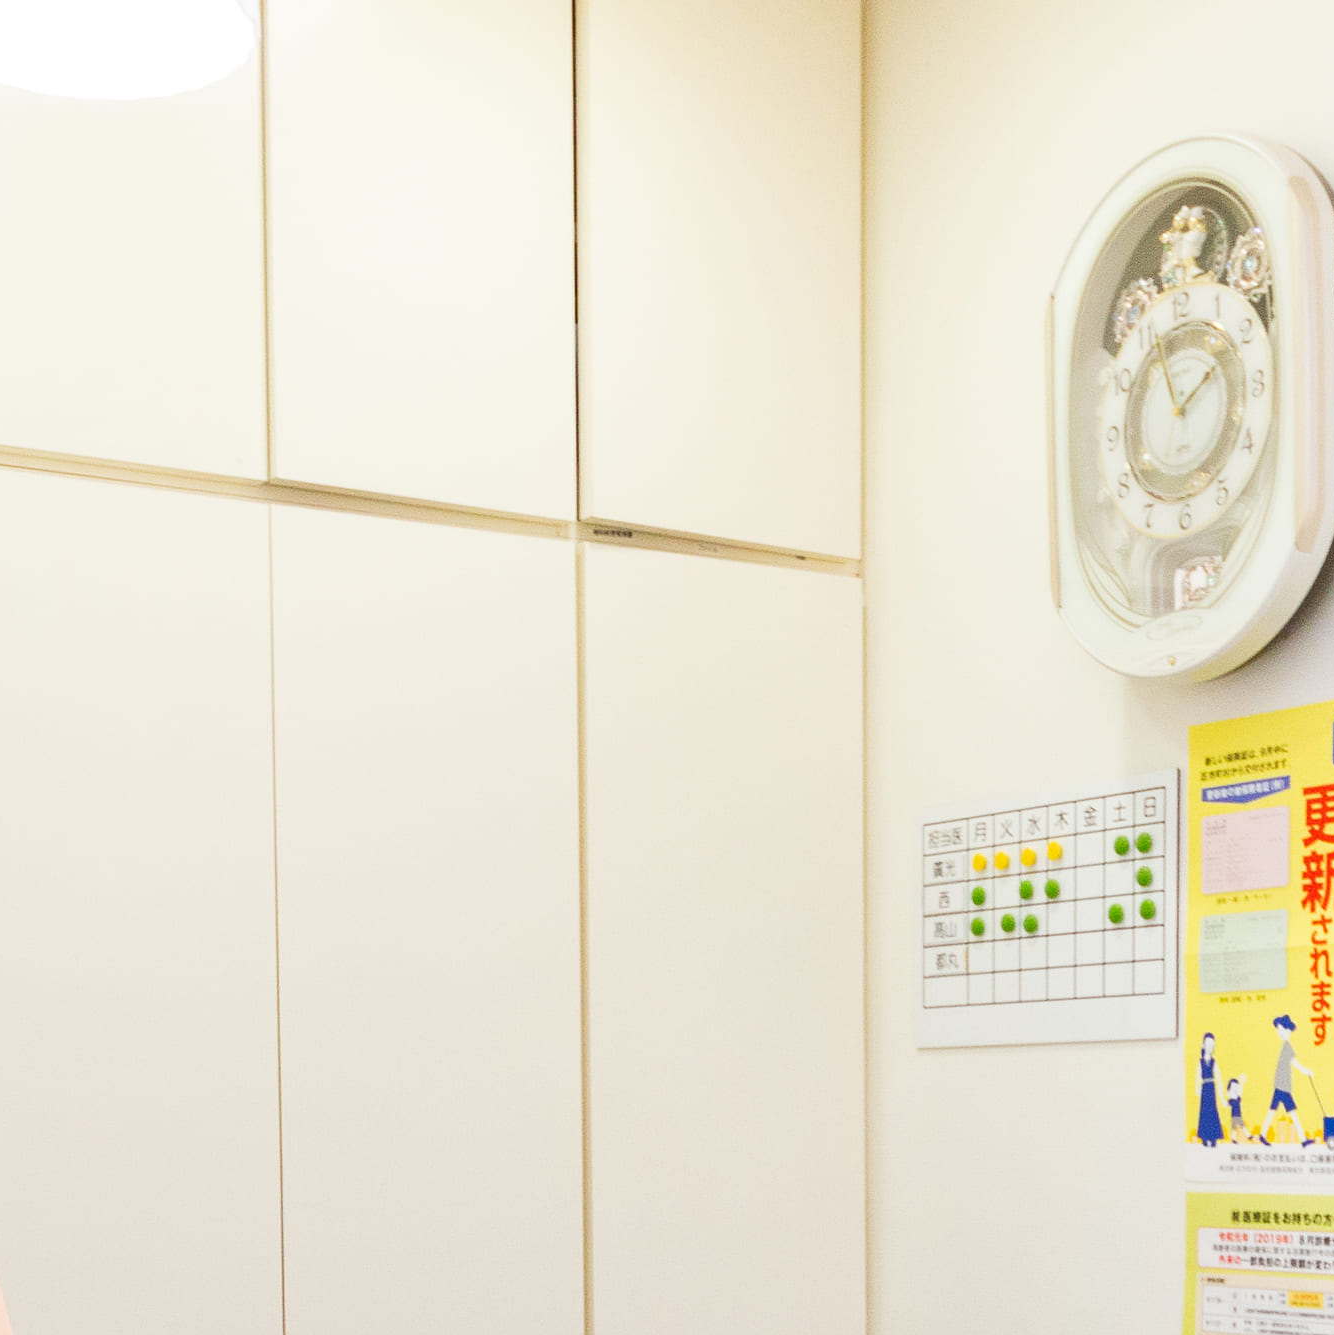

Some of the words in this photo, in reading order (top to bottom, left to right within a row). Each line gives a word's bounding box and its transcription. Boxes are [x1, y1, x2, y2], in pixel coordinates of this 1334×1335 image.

[1171, 291, 1191, 318] 12
[1214, 292, 1221, 317] 1
[1138, 321, 1153, 351] 11
[1238, 317, 1253, 344] 2
[1113, 367, 1132, 393] 10
[1251, 370, 1265, 399] 3
[1106, 425, 1120, 453] 9
[1241, 429, 1254, 454] 4
[1117, 473, 1130, 498] 8
[1215, 480, 1229, 507] 5
[1143, 504, 1155, 529] 7
[1179, 503, 1192, 530] 6
[974, 821, 987, 843] 月
[1000, 819, 1014, 839] 火
[1028, 815, 1042, 835] 水
[1054, 810, 1069, 827] 木
[1083, 805, 1097, 828] 金
[1112, 802, 1128, 823] 土
[1143, 796, 1157, 818] 日
